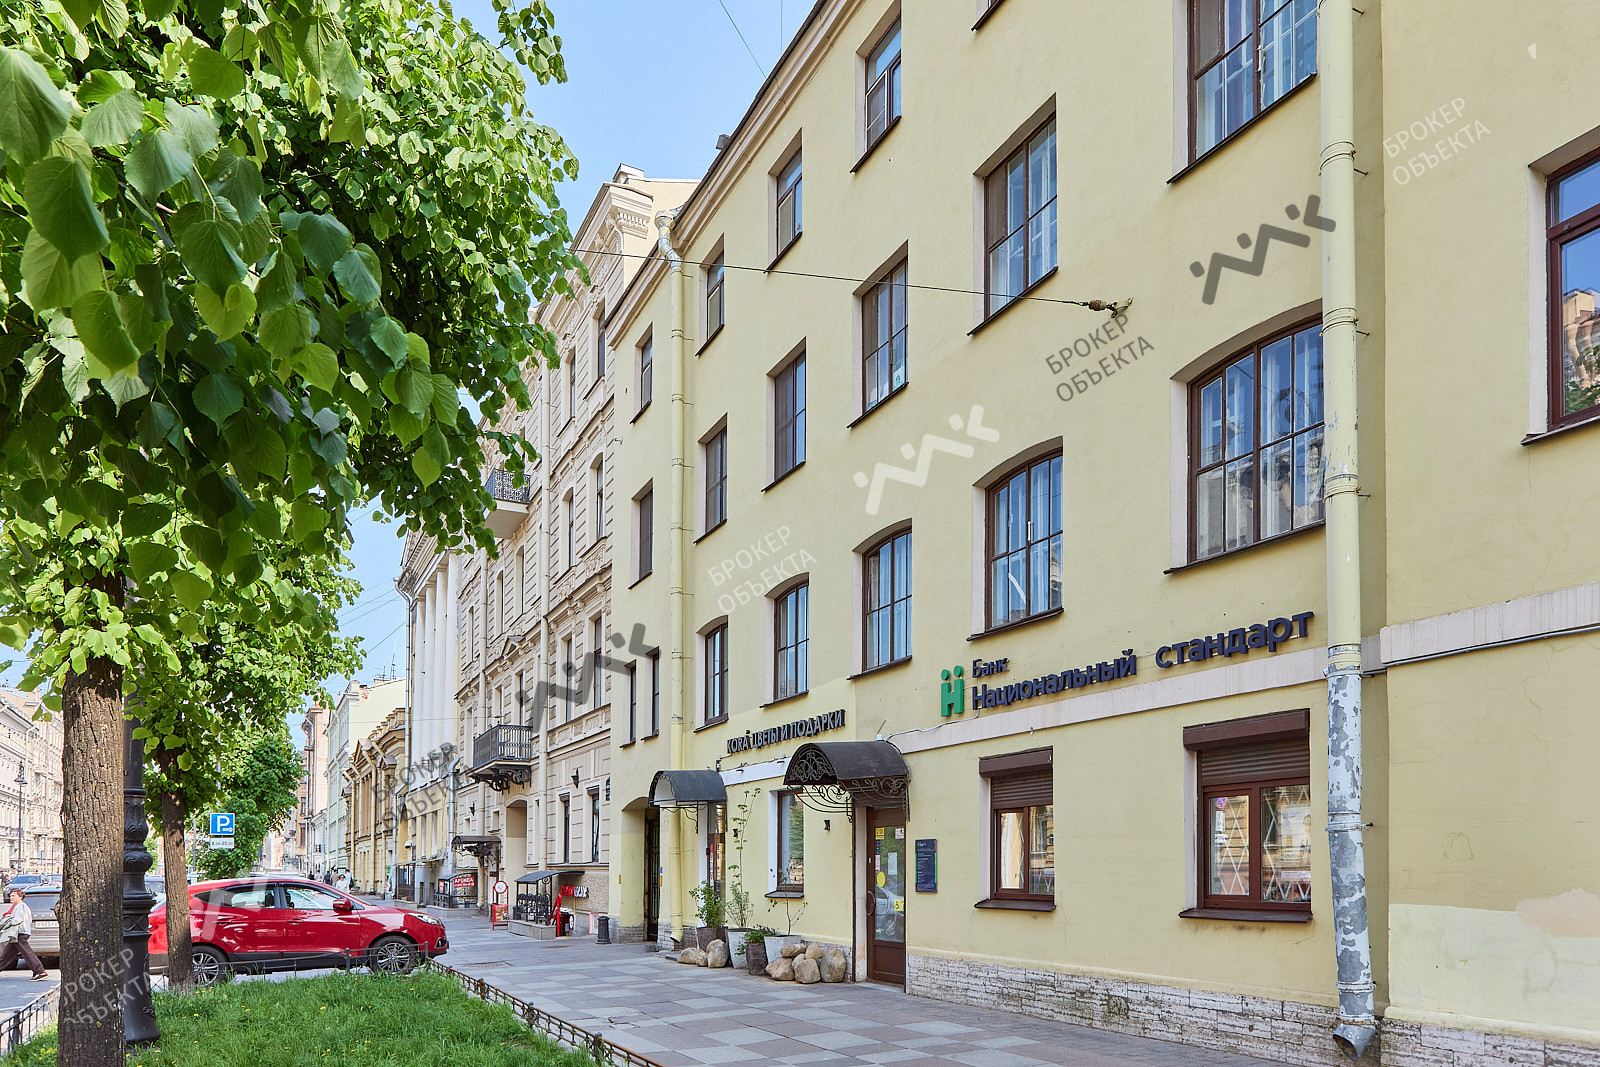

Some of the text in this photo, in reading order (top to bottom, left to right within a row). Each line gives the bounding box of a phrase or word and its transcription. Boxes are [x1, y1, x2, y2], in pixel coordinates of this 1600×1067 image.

[972, 611, 1315, 710] Национальный стандарт
[972, 657, 1011, 679] Банк
[751, 726, 782, 749] ЦВЕТЫ
[780, 723, 791, 741] И
[789, 708, 846, 738] ПОДАРКИ
[216, 815, 231, 833] P
